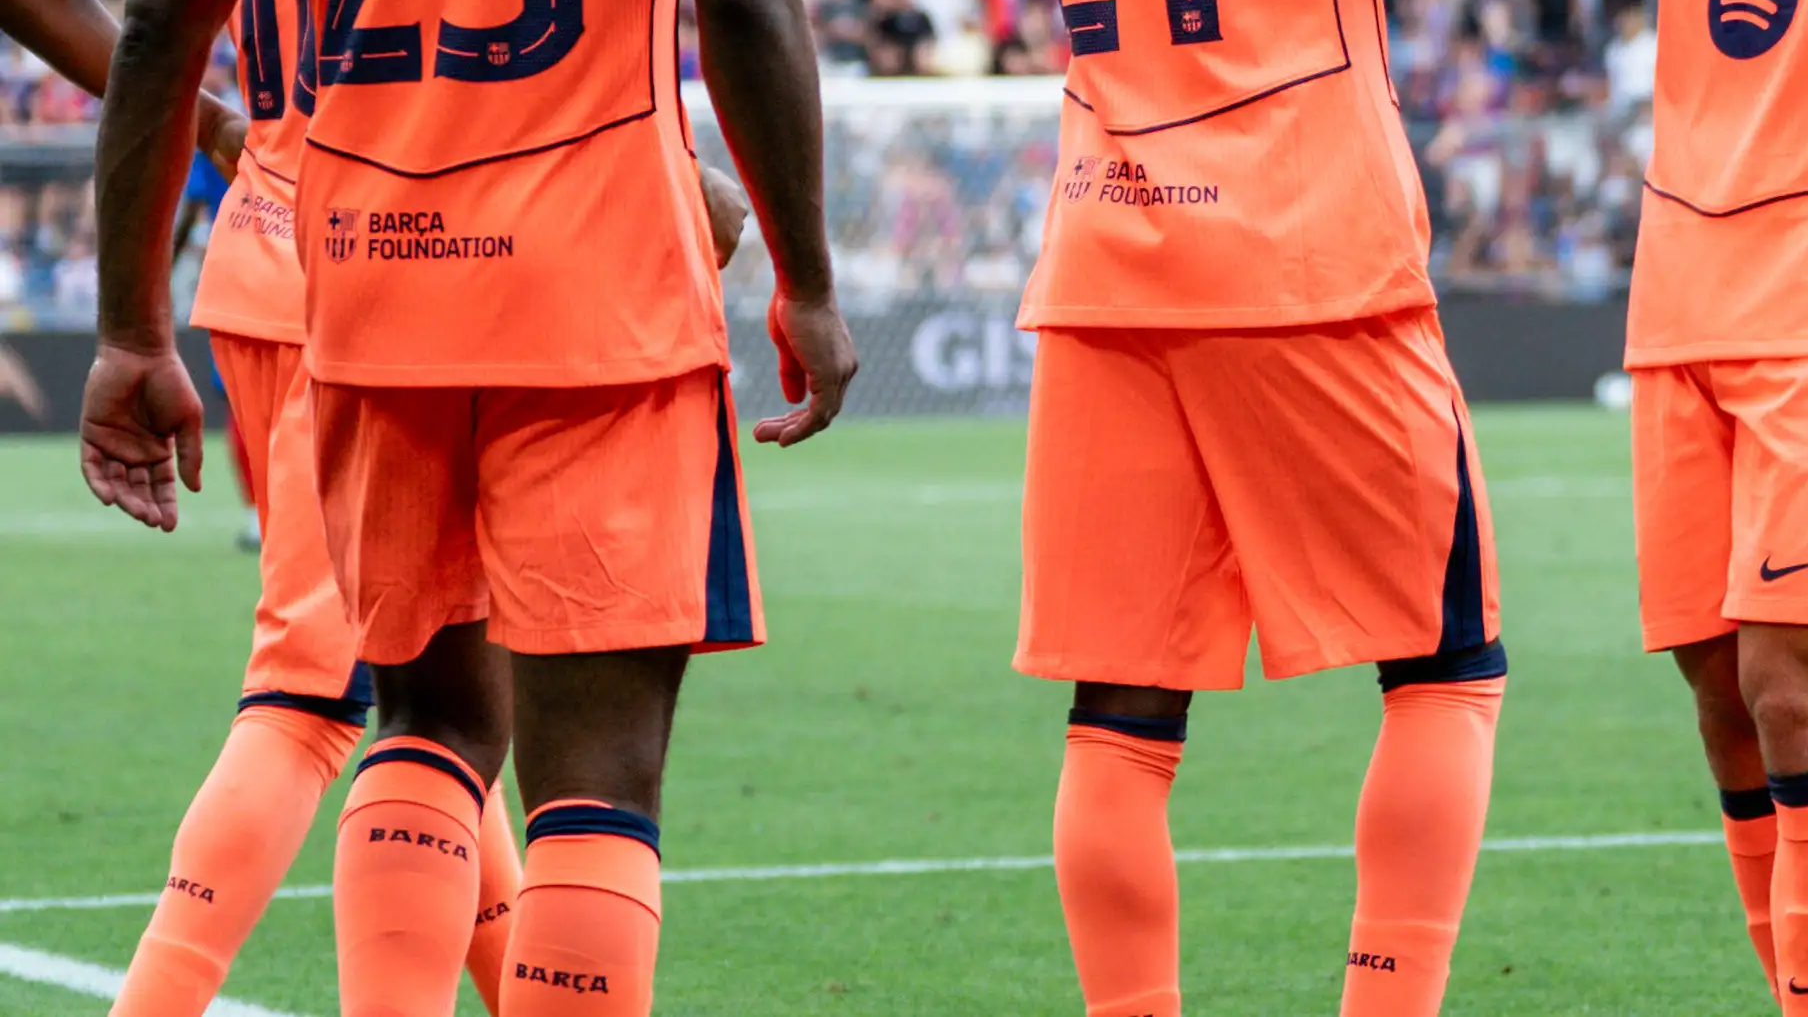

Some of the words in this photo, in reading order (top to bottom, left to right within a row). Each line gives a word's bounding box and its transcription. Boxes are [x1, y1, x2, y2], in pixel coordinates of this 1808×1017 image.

[1098, 184, 1219, 207] FOUDATION
[368, 212, 445, 237] BARÇA
[367, 235, 514, 260] FOUNDATION
[368, 827, 469, 862] BARÇA
[167, 875, 216, 904] ARÇA
[1346, 951, 1396, 973] ARÇA
[515, 962, 609, 994] BARÇA
